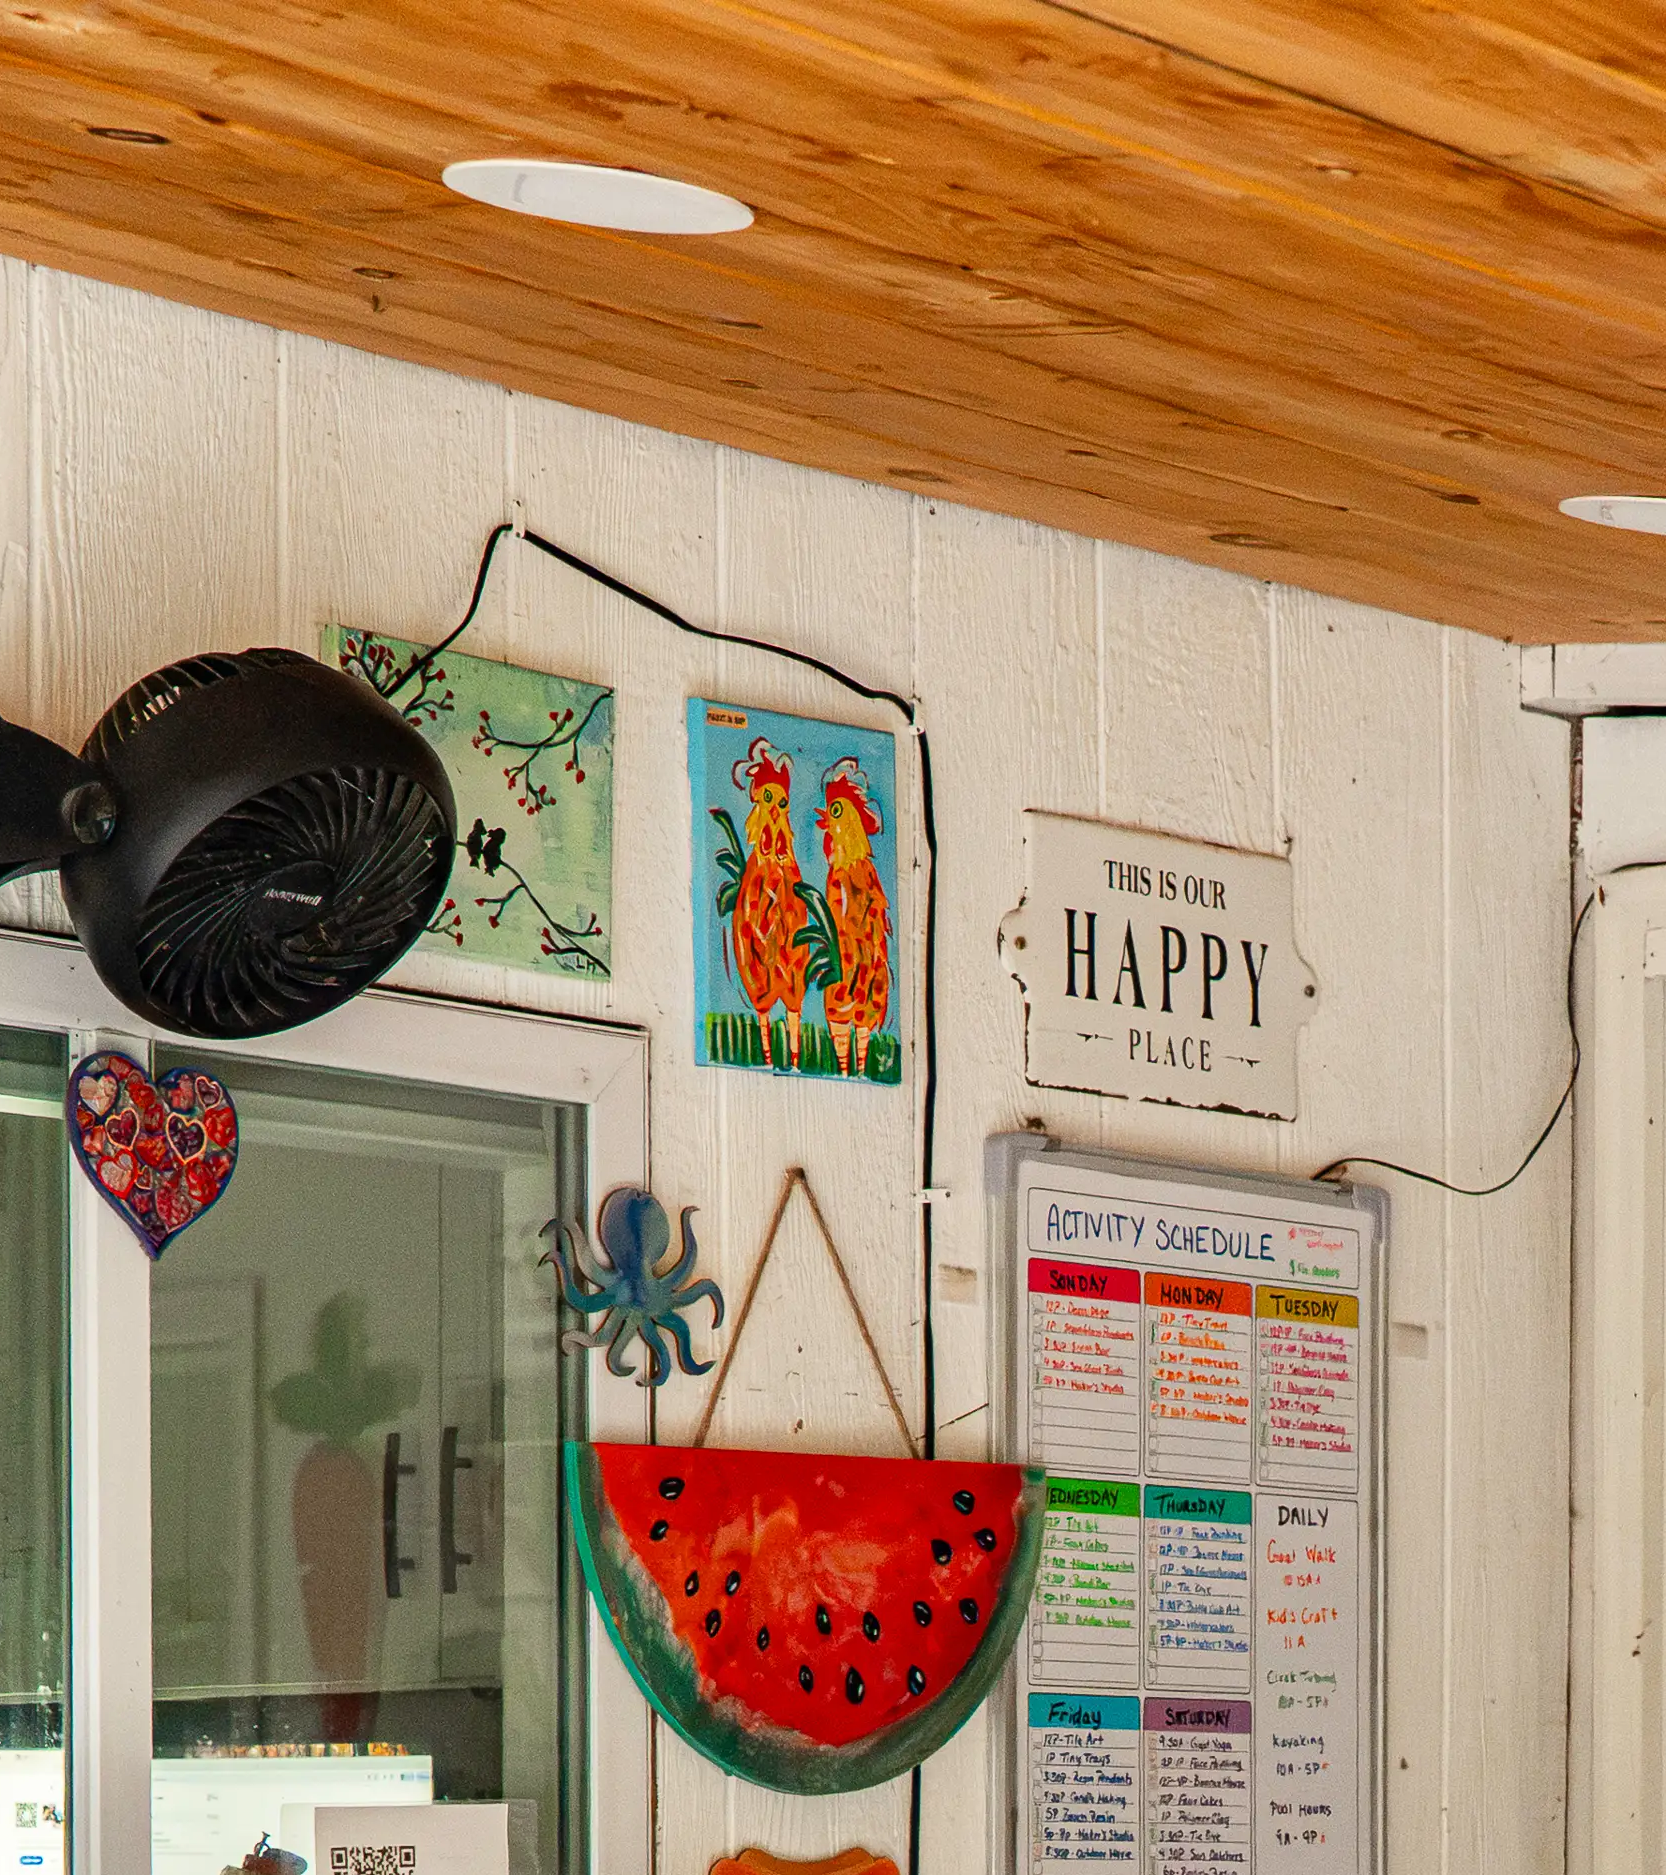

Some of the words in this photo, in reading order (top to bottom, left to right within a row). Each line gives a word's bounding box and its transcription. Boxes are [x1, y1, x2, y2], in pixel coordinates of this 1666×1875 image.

[1103, 859, 1152, 897] THIS
[1159, 870, 1177, 901] IS
[1184, 874, 1227, 911] OUR
[1063, 907, 1269, 1028] HAPPY
[1129, 1028, 1212, 1073] PLACE
[1047, 1203, 1145, 1248] ACTIVITY
[1156, 1219, 1276, 1262] SCHEDULE
[1160, 1282, 1224, 1309] MONDAY
[1270, 1294, 1339, 1322] TUESDAY
[1046, 1487, 1119, 1511] EDNESDAY
[1153, 1493, 1226, 1518] THURSDAY
[1278, 1506, 1328, 1528] DAILY
[1305, 1544, 1337, 1564] Walk
[1047, 1702, 1101, 1730] Friday
[1086, 1732, 1104, 1746] Art
[1059, 1752, 1082, 1767] Tiny
